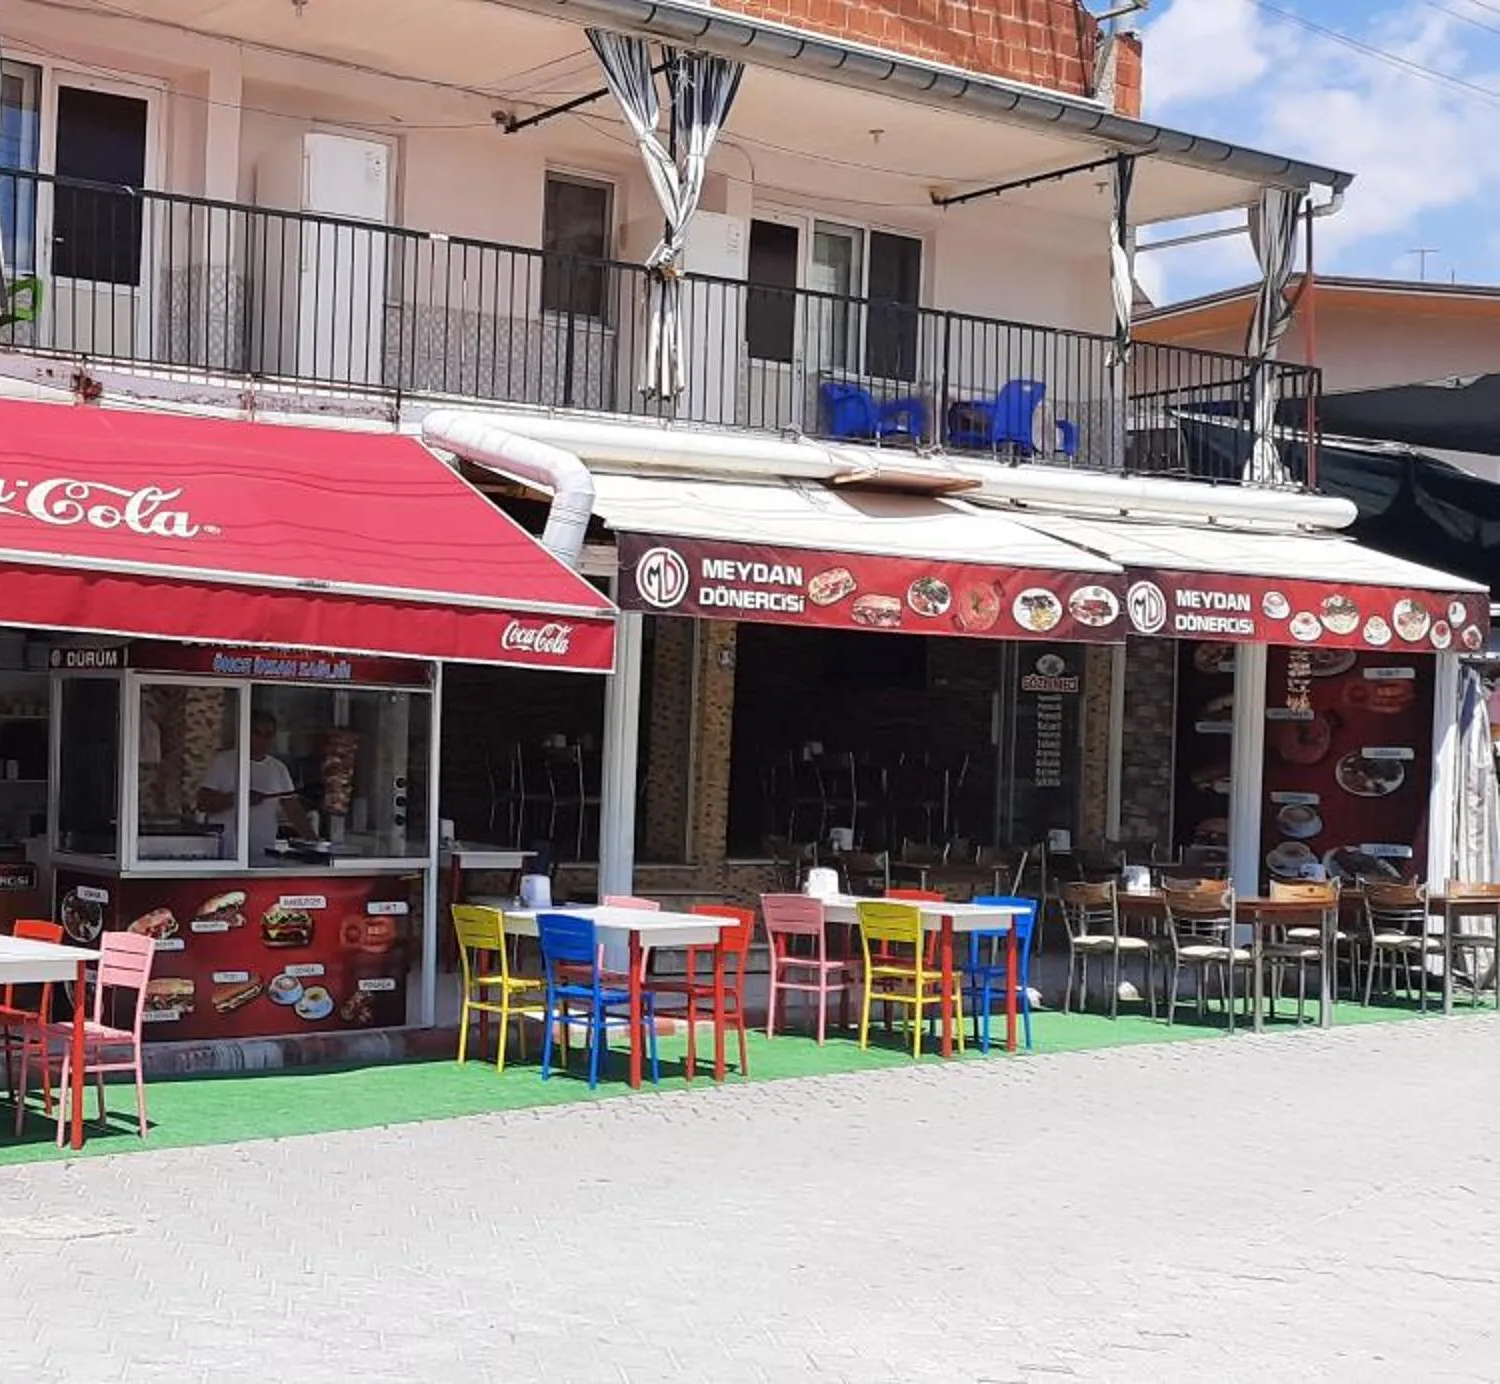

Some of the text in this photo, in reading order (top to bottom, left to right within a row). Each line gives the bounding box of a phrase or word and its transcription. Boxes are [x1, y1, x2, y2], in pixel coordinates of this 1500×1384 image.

[701, 558, 804, 587] MEYDAN
[699, 587, 805, 613] DÖNERCİSİ
[1175, 589, 1251, 612] MEYDAN
[502, 620, 574, 656] Coca-Cola
[66, 650, 118, 667] DÜRÜM
